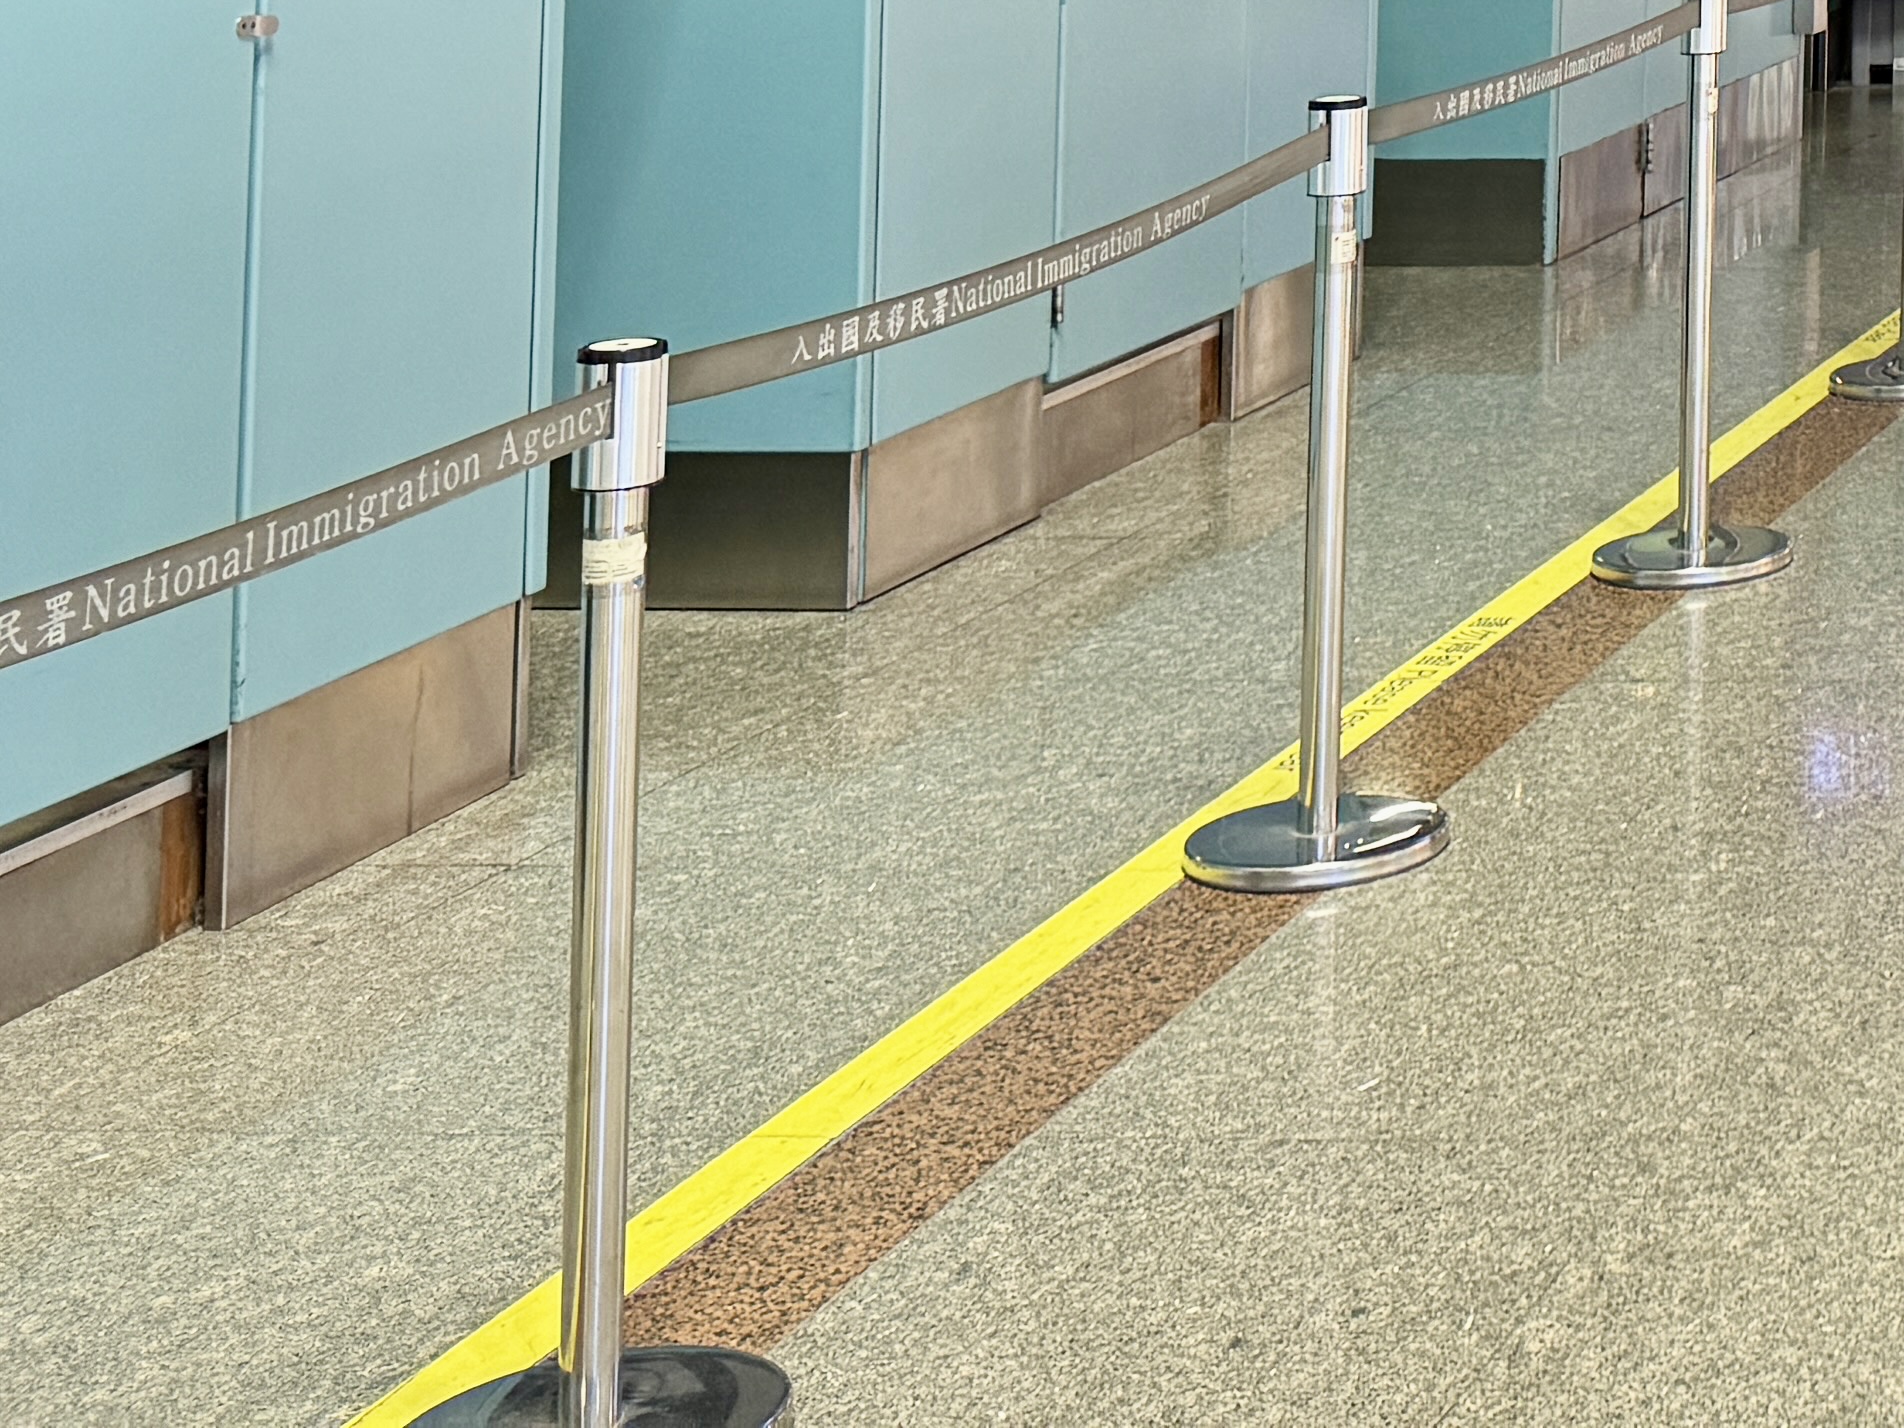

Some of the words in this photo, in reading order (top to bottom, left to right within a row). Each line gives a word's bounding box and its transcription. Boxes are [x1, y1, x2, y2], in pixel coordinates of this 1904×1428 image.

[949, 260, 1033, 318] National
[1036, 224, 1143, 289] Immigration
[1149, 194, 1211, 244] Agency
[82, 530, 256, 632] National
[263, 451, 482, 566] Immigration
[496, 398, 613, 471] Agency
